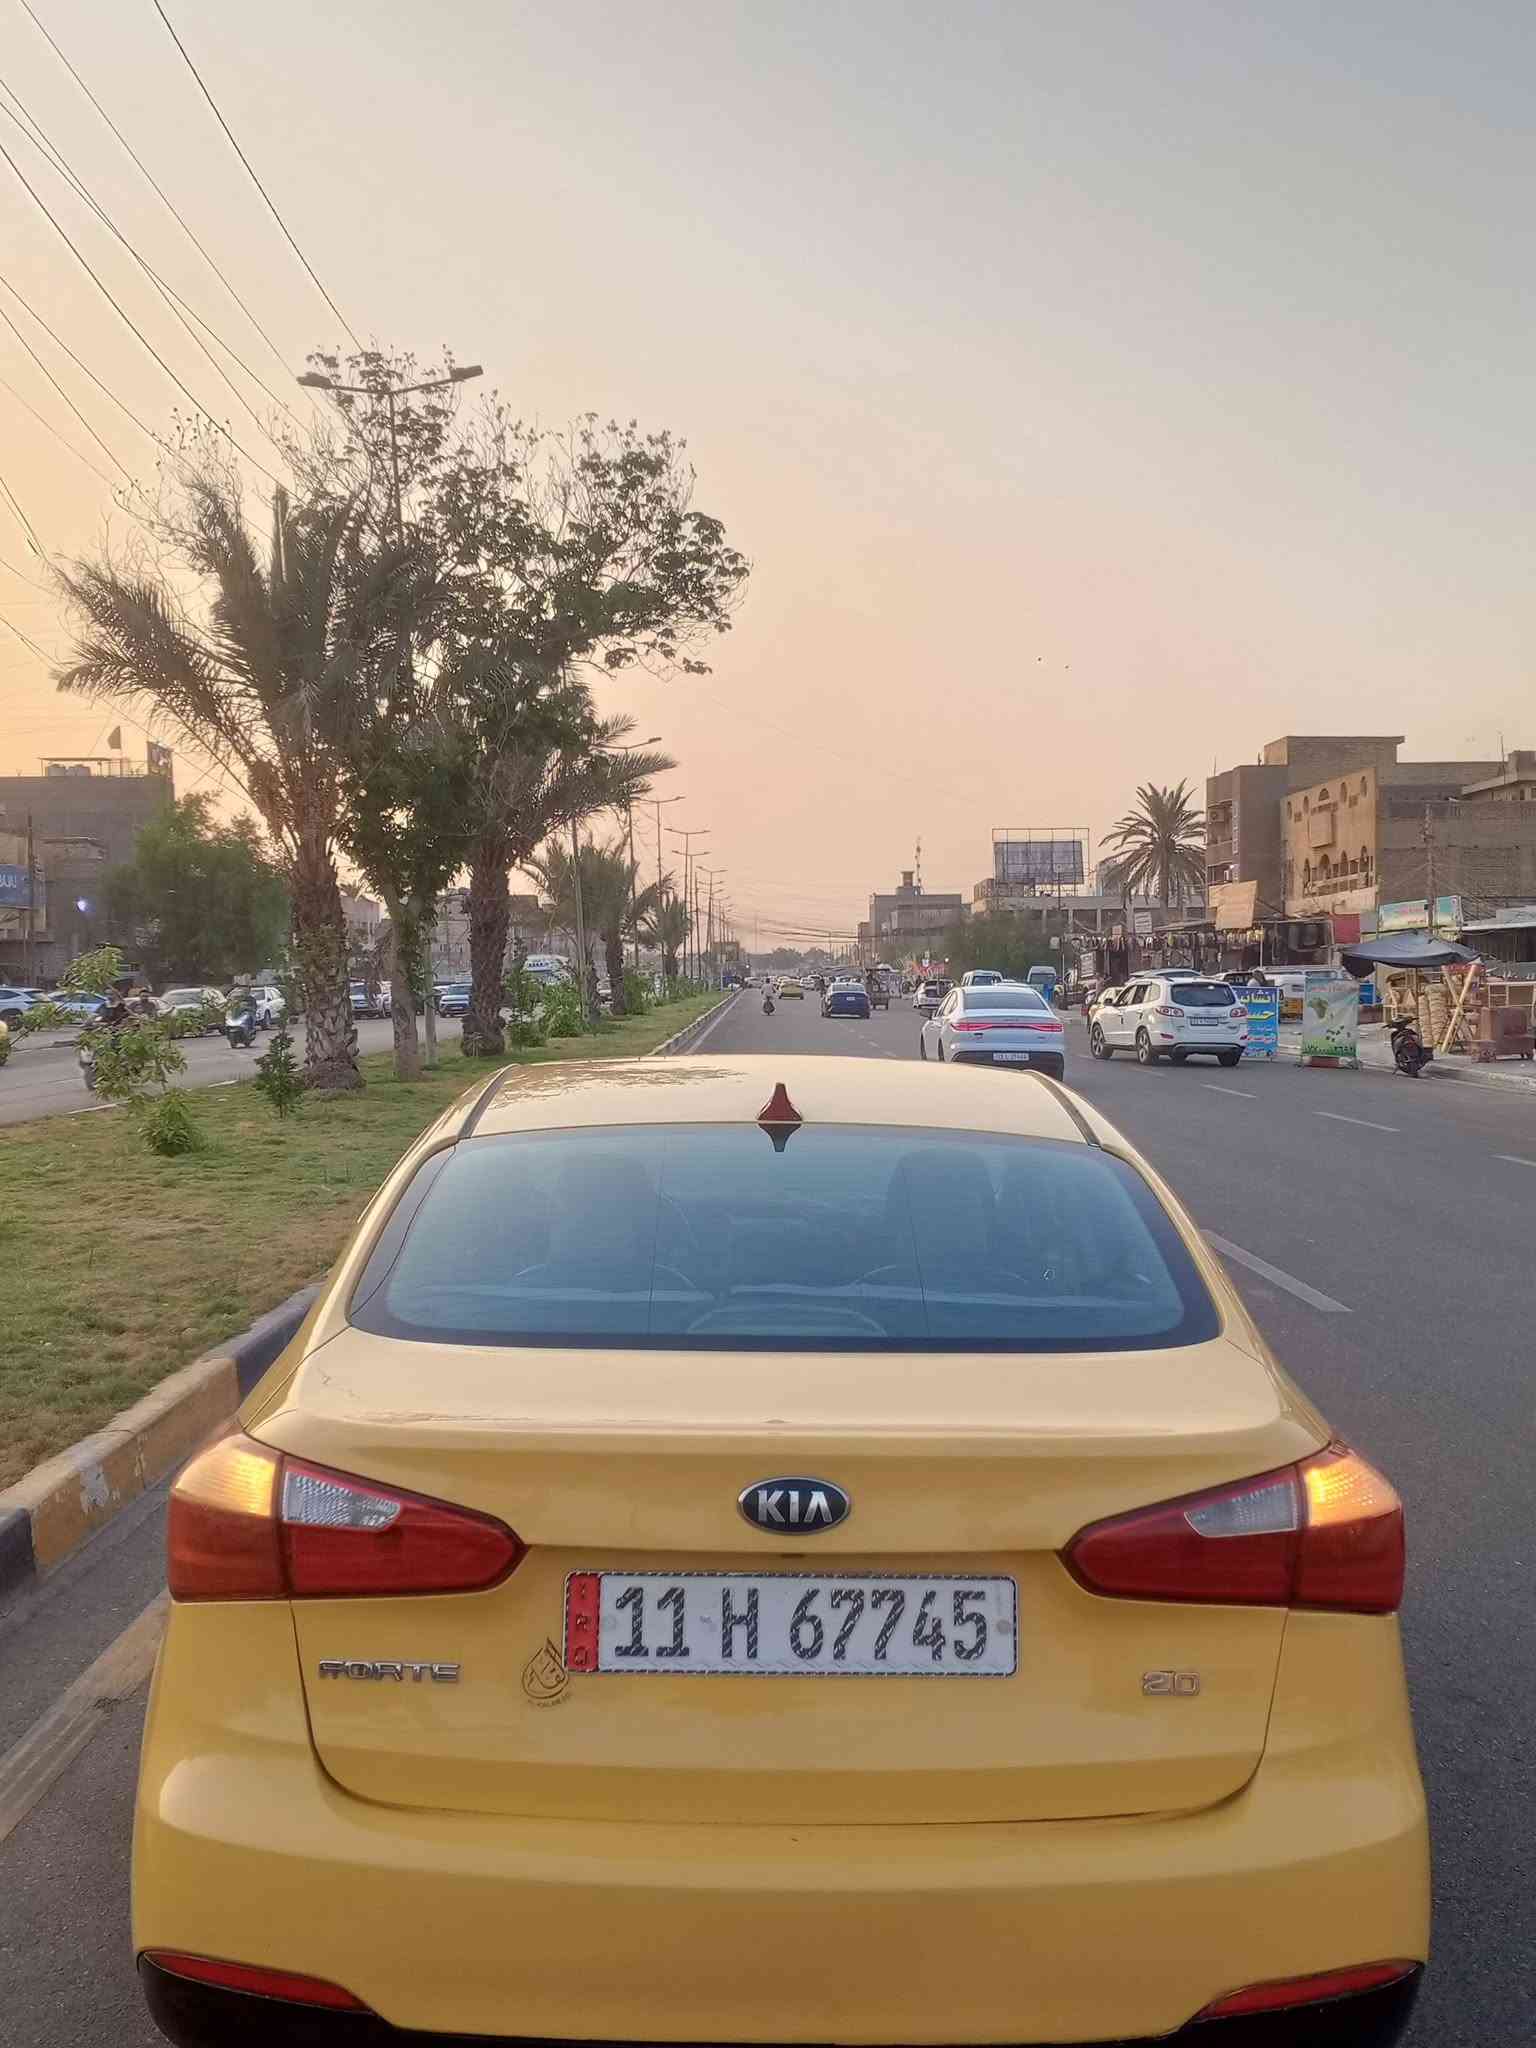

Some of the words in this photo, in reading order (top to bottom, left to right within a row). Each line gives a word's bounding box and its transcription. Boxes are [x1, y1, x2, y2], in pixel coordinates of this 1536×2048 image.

[756, 1488, 834, 1523] KIA
[614, 1585, 691, 1658] 11
[721, 1587, 759, 1660] H
[789, 1588, 988, 1661] 67745
[318, 1658, 462, 1684] FORTE
